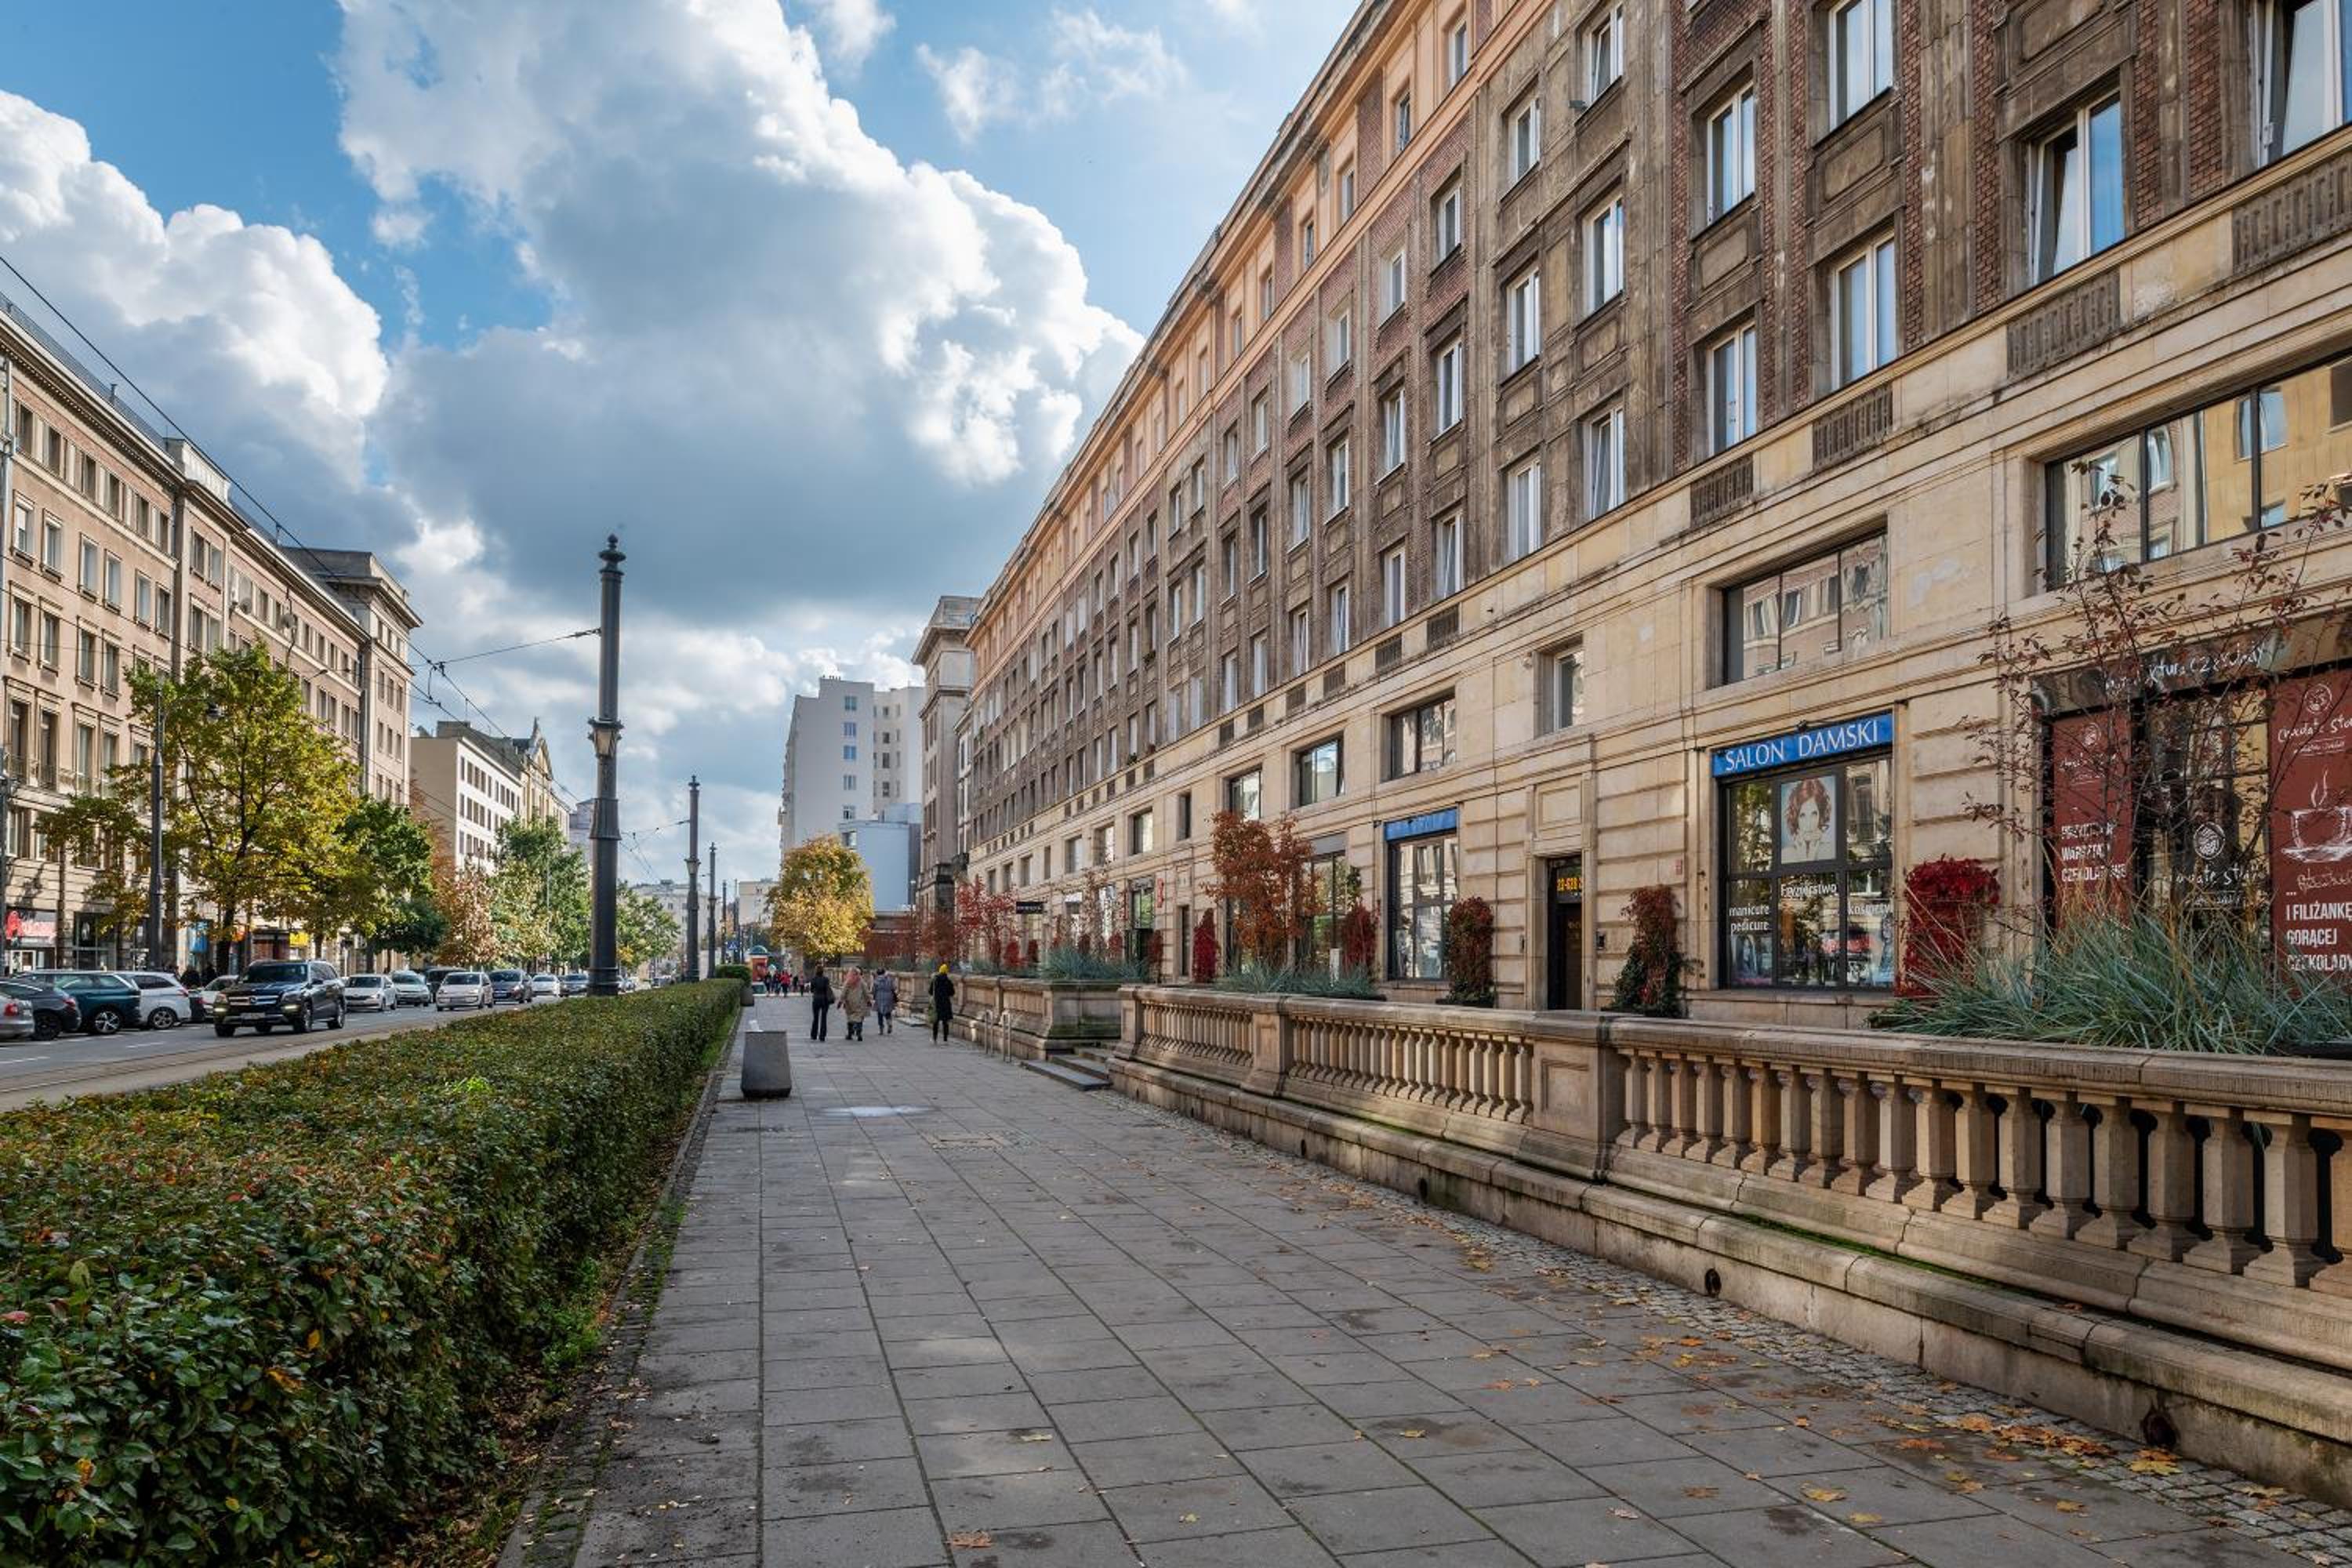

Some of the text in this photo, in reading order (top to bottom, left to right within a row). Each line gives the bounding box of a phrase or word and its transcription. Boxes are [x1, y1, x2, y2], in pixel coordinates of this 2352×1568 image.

[1726, 720, 1878, 771] SALON DAMSKI
[1730, 903, 1769, 916] manicure
[2286, 899, 2352, 921] I FILIŻANKĘ
[1731, 918, 1769, 933] pedicure
[2287, 927, 2337, 948] GORĄCEJ
